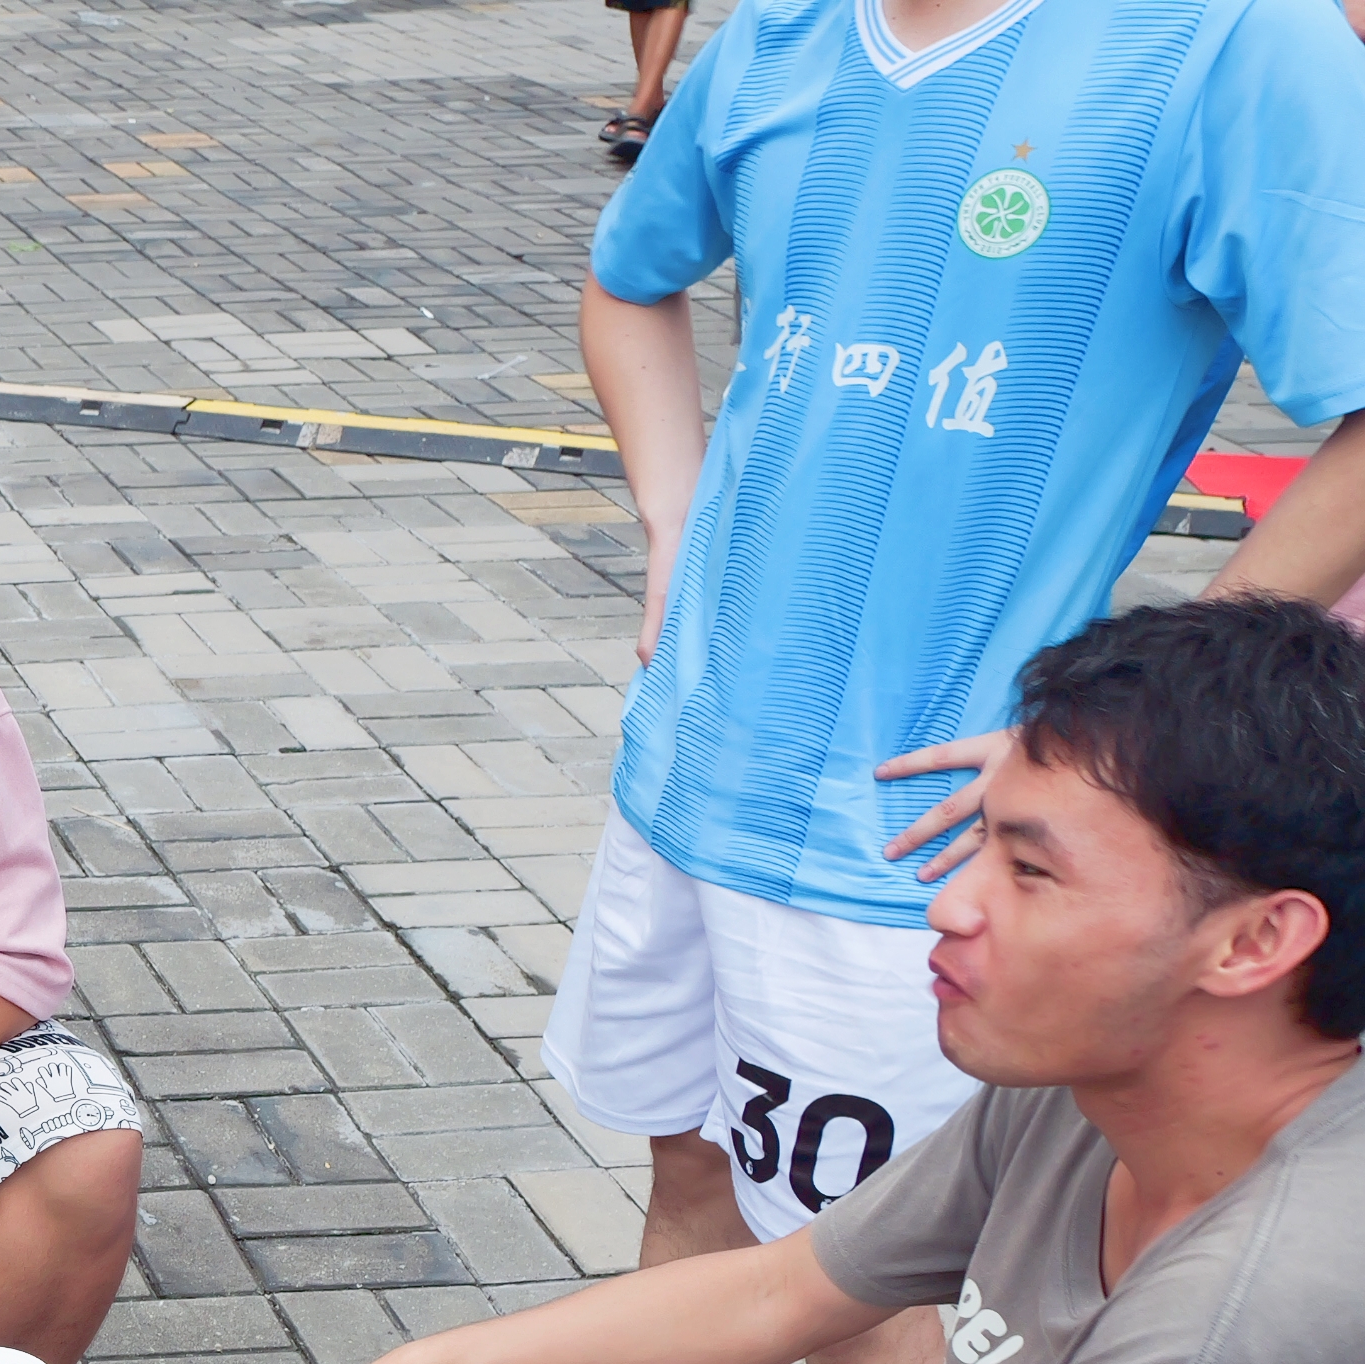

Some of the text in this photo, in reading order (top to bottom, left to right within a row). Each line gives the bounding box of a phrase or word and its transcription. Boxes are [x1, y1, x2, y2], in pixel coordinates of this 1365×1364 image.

[723, 297, 1009, 438] 行四值
[728, 1056, 895, 1214] 30
